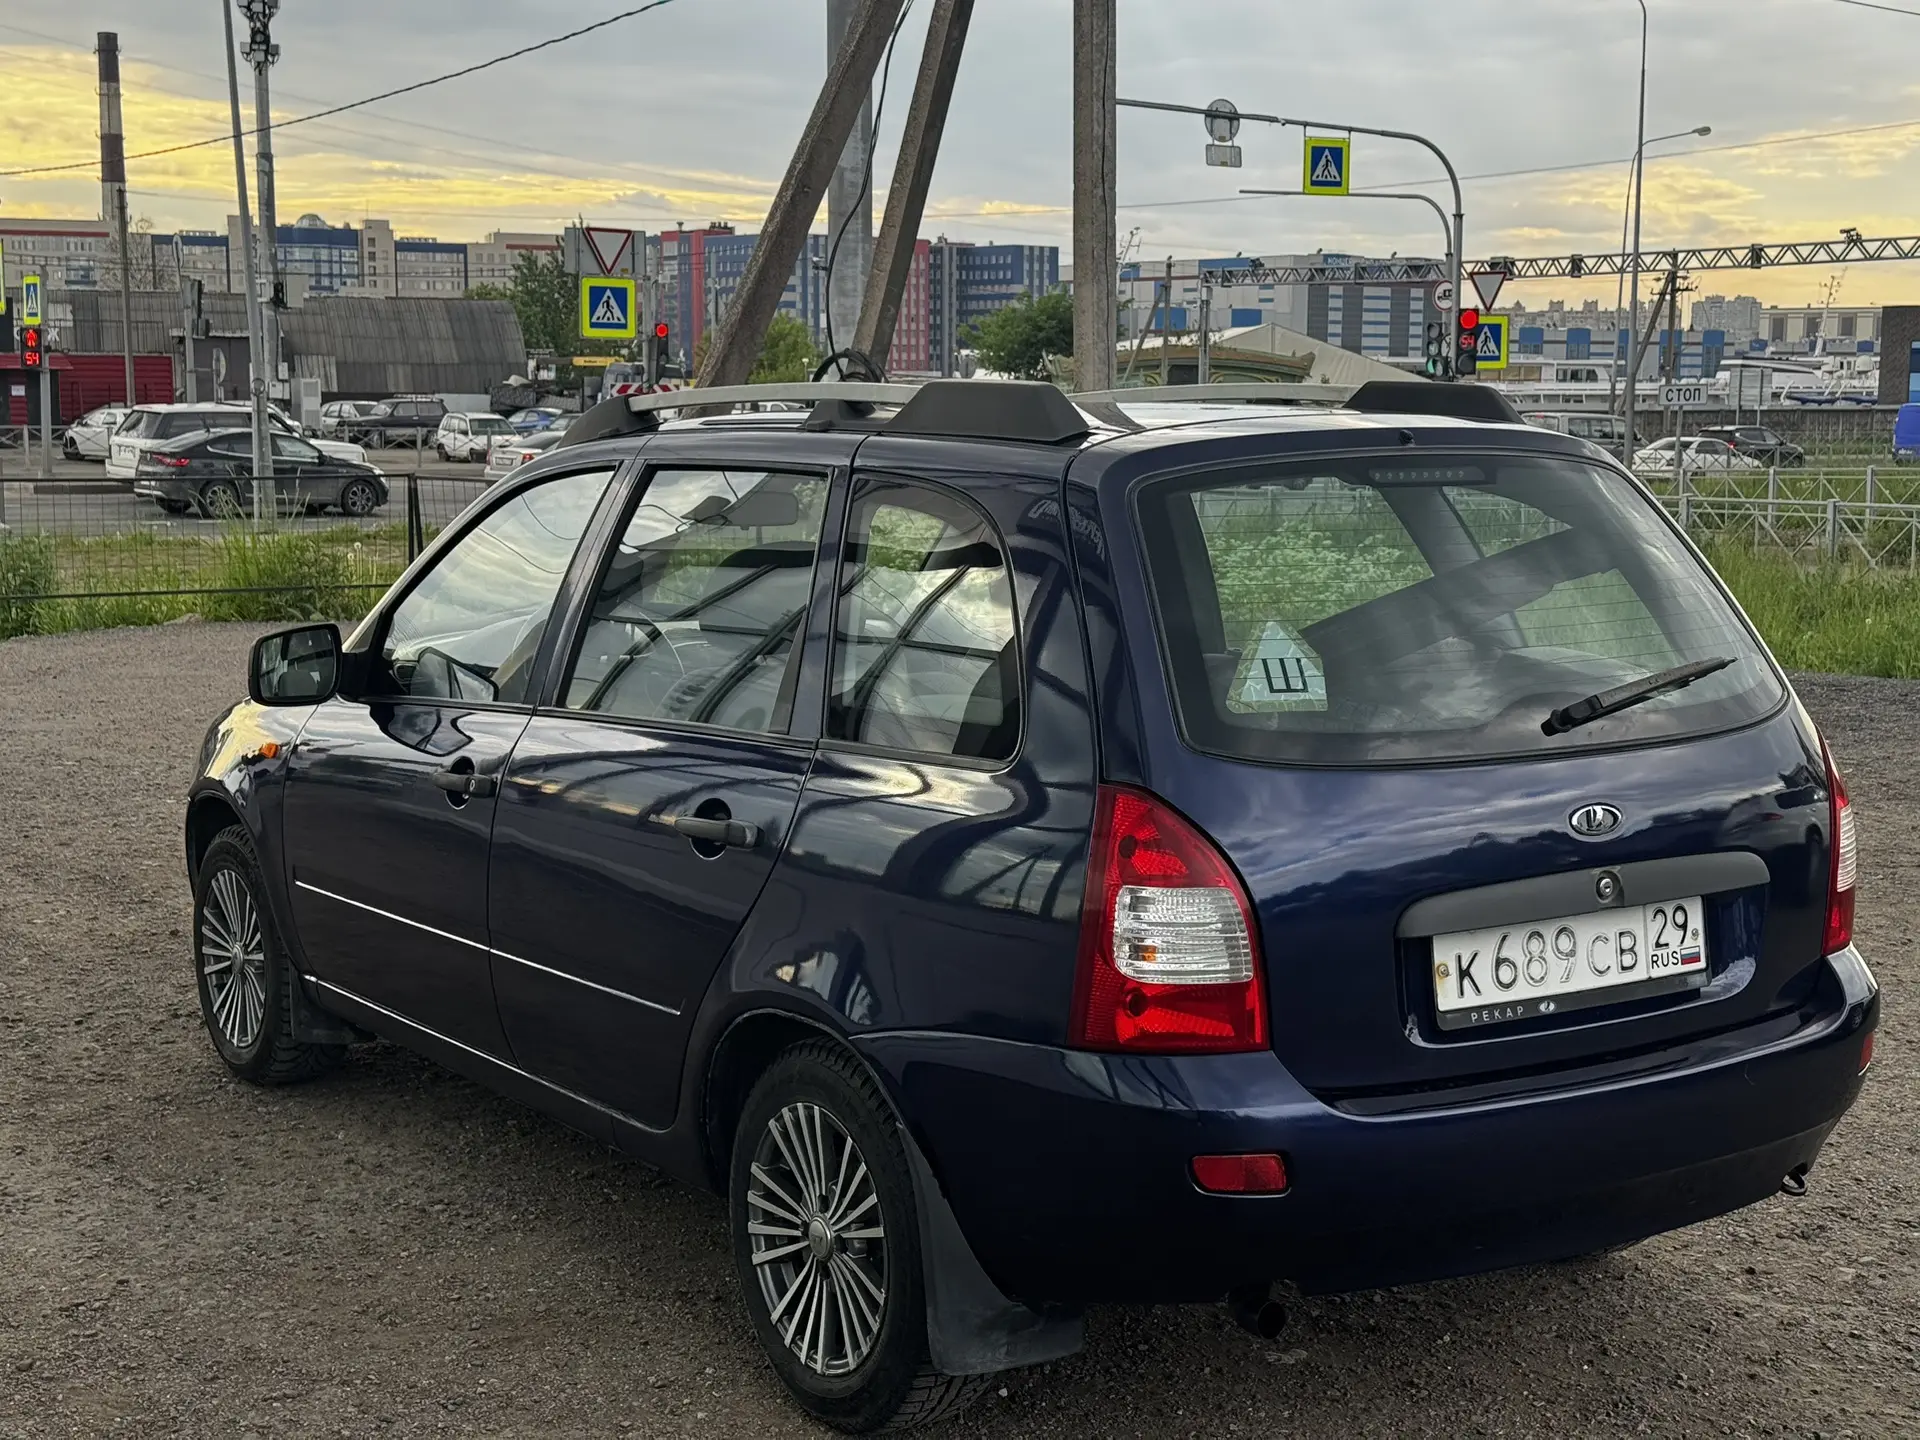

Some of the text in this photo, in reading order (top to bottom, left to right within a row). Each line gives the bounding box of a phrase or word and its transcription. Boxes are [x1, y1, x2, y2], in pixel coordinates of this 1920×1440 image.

[25, 352, 39, 365] 54
[1665, 388, 1701, 402] СТОП
[1262, 658, 1308, 693] Ш
[1651, 904, 1689, 950] 29
[1651, 951, 1680, 969] RUS
